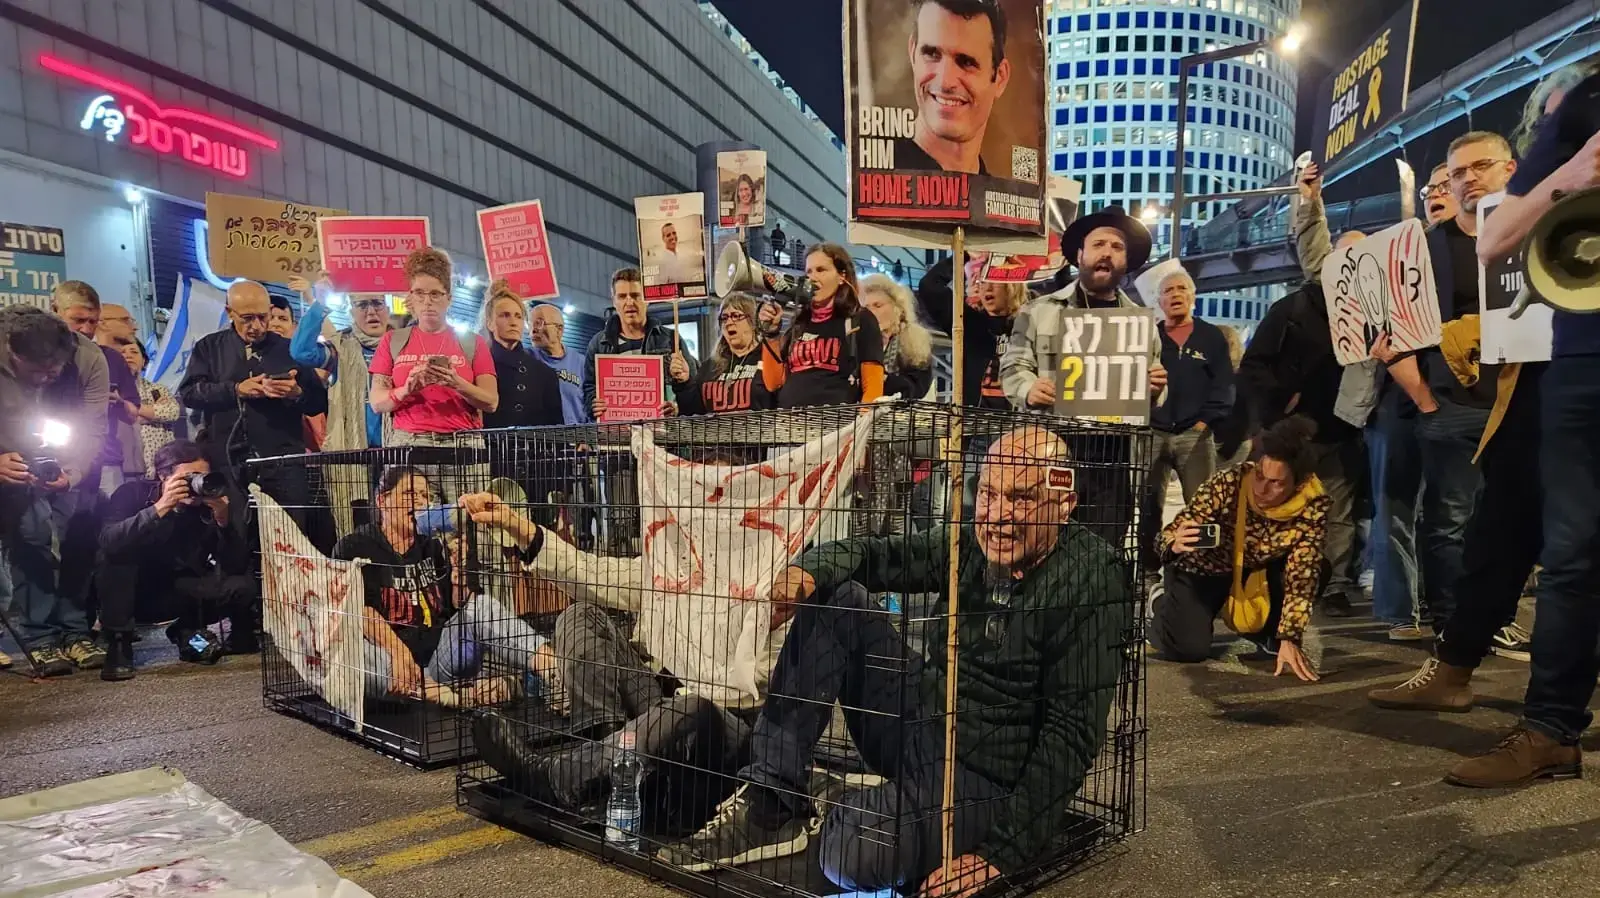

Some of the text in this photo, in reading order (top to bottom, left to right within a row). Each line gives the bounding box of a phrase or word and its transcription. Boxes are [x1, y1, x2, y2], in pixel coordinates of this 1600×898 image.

[1332, 28, 1392, 101] HOSTAGE
[858, 106, 915, 139] BRING
[1328, 84, 1360, 131] DEAL
[124, 105, 248, 177] שופרסל
[1324, 112, 1358, 163] NOW
[859, 138, 895, 170] HIM
[859, 173, 970, 208] HOME NOW!
[985, 200, 1040, 222] FAMILIES FORUM
[4, 227, 62, 253] סירוב
[227, 230, 302, 253] החטופות
[333, 238, 416, 251] מי שהפקיר
[490, 238, 541, 260] עסקה
[331, 255, 389, 269] להחזיר
[1061, 313, 1149, 353] עד לא
[788, 338, 840, 370] NOW!
[624, 380, 651, 388] מספיק
[1061, 355, 1148, 400] נדע?
[603, 391, 657, 407] עסקה
[641, 410, 652, 418] על
